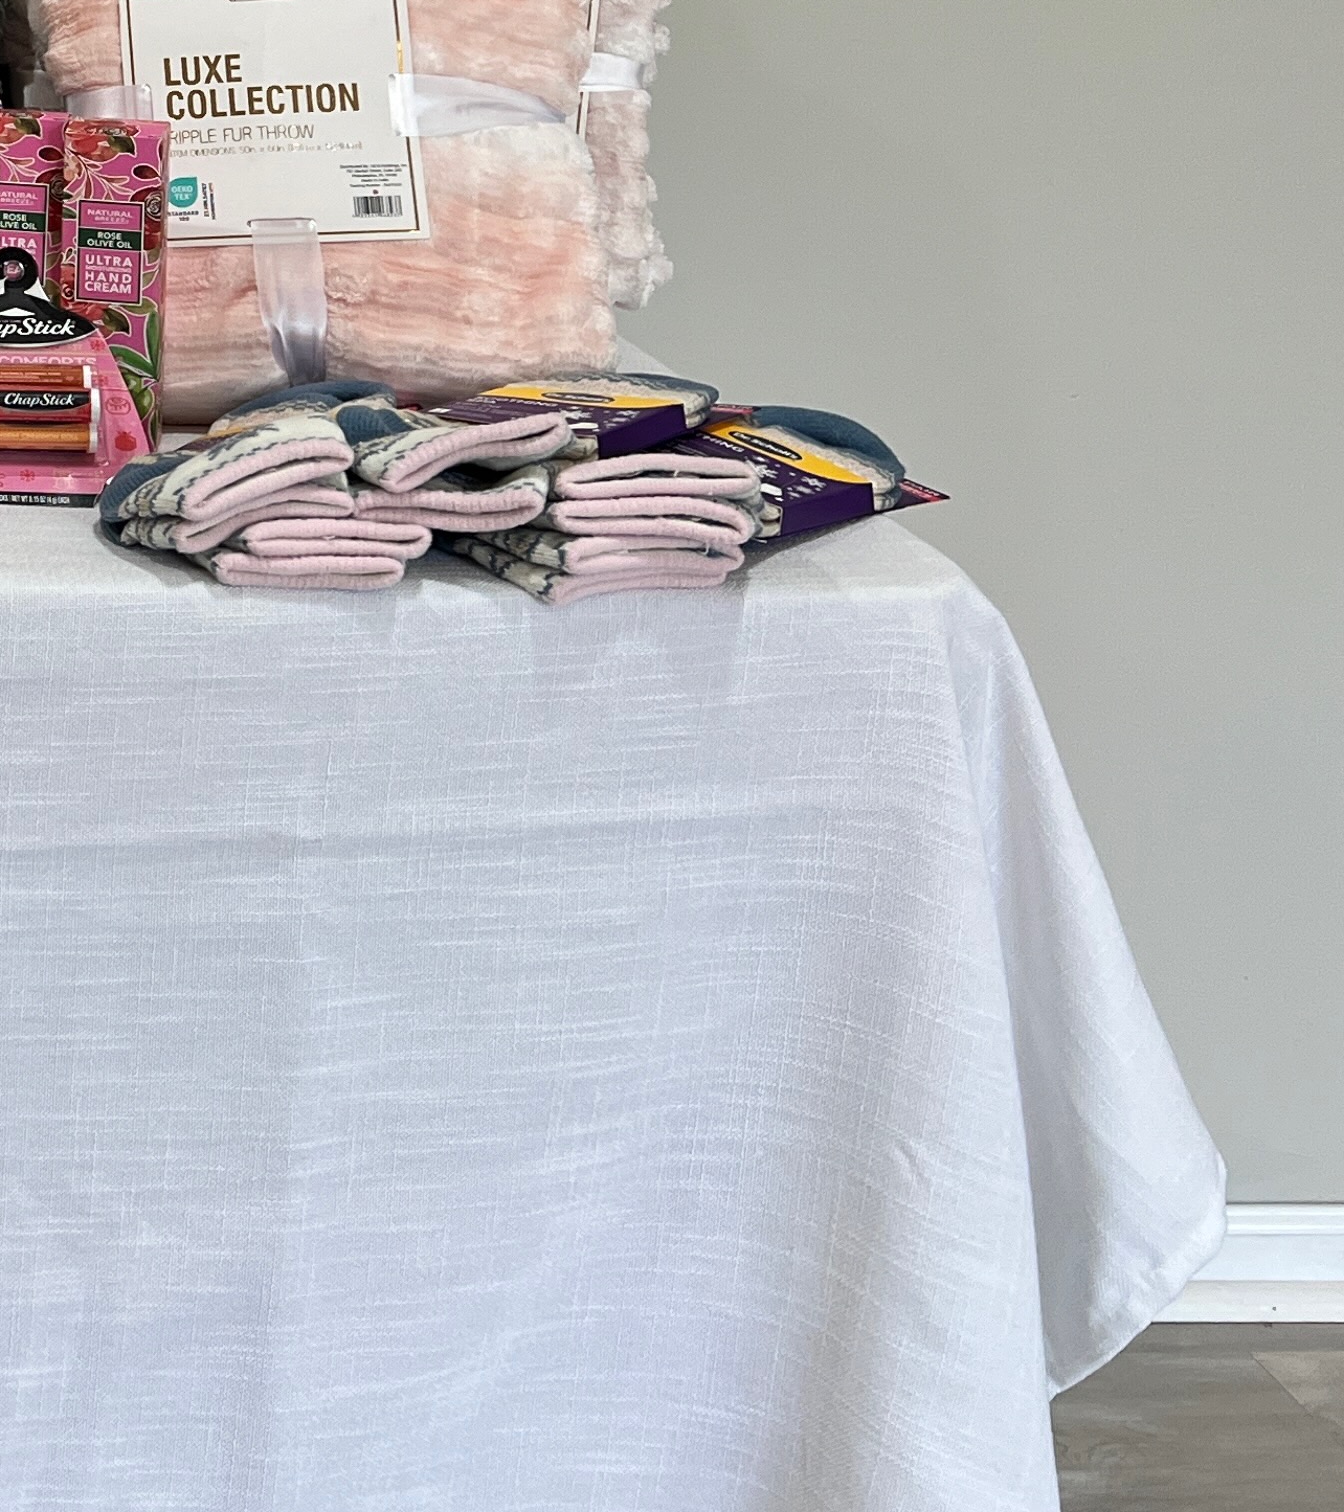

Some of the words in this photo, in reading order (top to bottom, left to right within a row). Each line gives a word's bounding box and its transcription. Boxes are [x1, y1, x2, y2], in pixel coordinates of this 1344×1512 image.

[162, 53, 243, 86] LUXE
[165, 82, 361, 120] COLLECTION
[169, 128, 216, 145] RIPPLE
[223, 126, 253, 143] FUR
[256, 124, 315, 141] THROW
[171, 185, 194, 193] OEKO
[2, 213, 27, 222] ROSE
[87, 209, 134, 219] NATURAL
[21, 221, 38, 230] OIL
[97, 231, 123, 241] ROSE
[87, 239, 115, 248] OLIVE
[116, 240, 133, 249] OIL
[84, 254, 133, 267] ULTRA
[84, 272, 133, 285] HAND
[84, 282, 132, 295] CREAM
[4, 393, 75, 407] ChapStick
